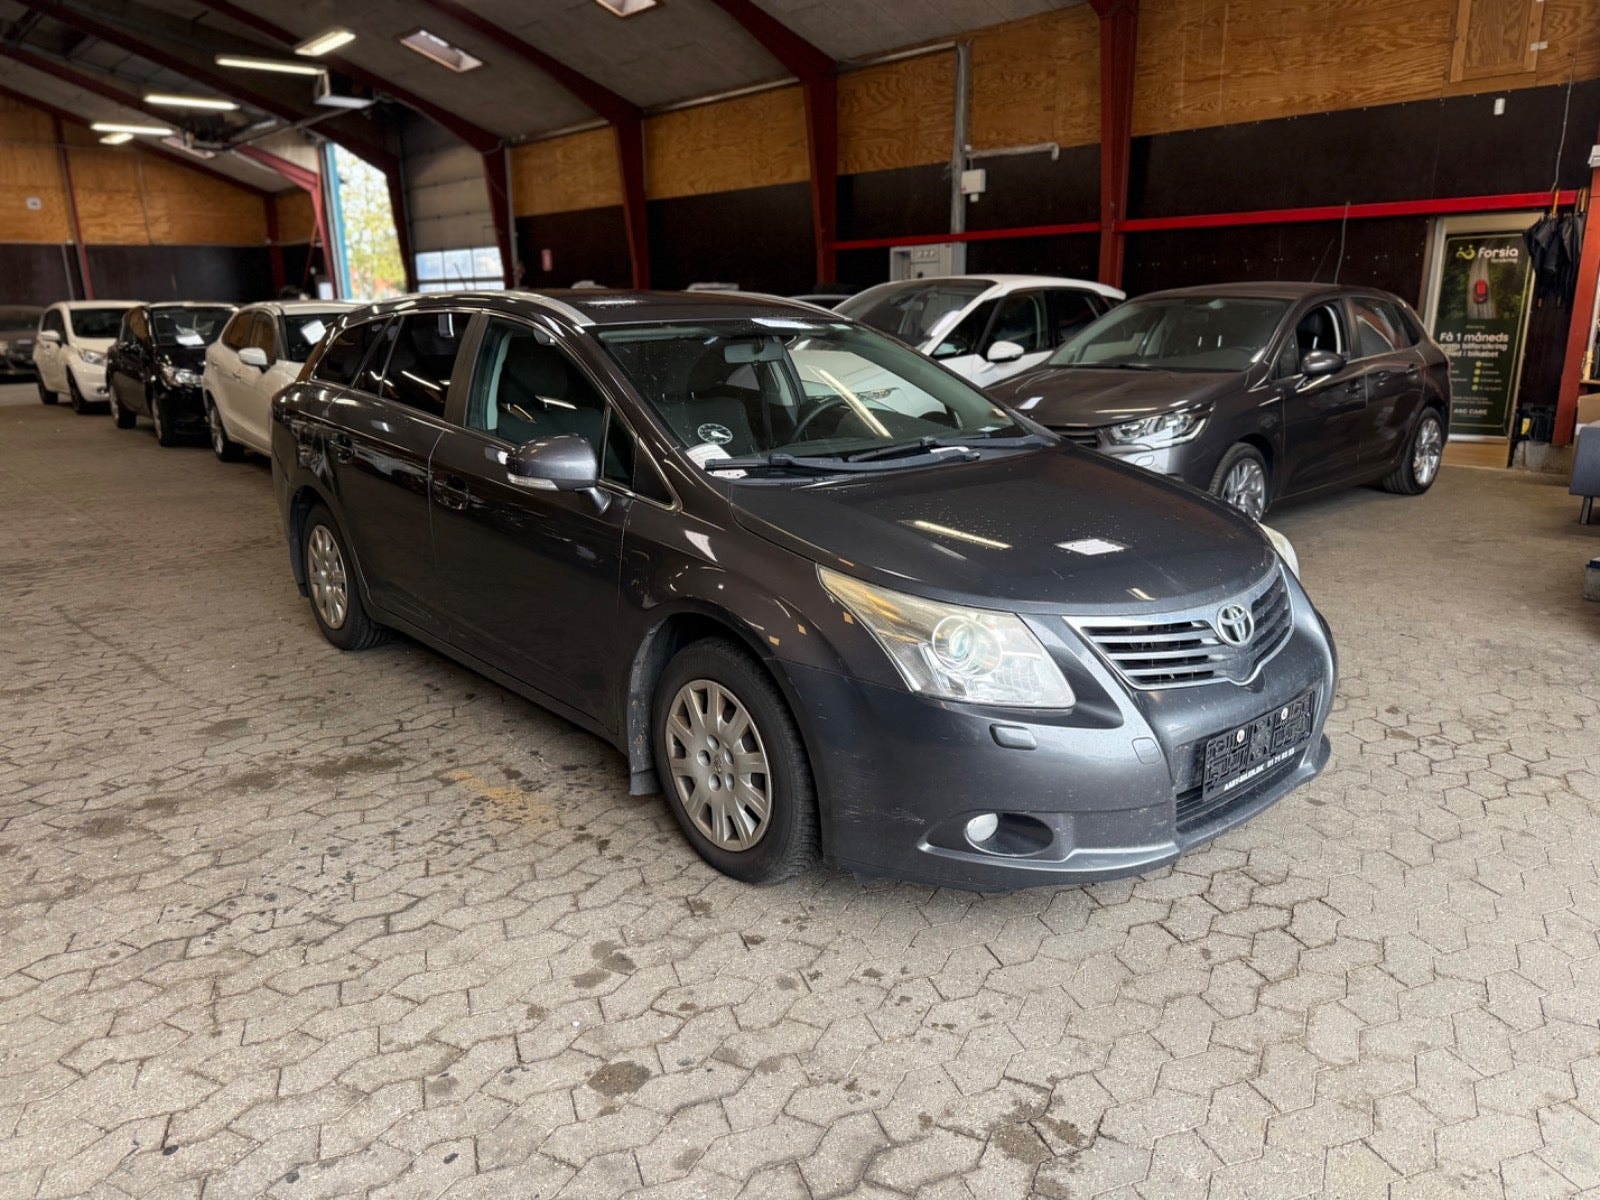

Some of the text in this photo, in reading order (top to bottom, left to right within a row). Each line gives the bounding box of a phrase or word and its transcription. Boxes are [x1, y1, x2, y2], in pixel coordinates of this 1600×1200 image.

[1478, 246, 1518, 258] forsia
[1440, 332, 1509, 342] Få 1 måneds
